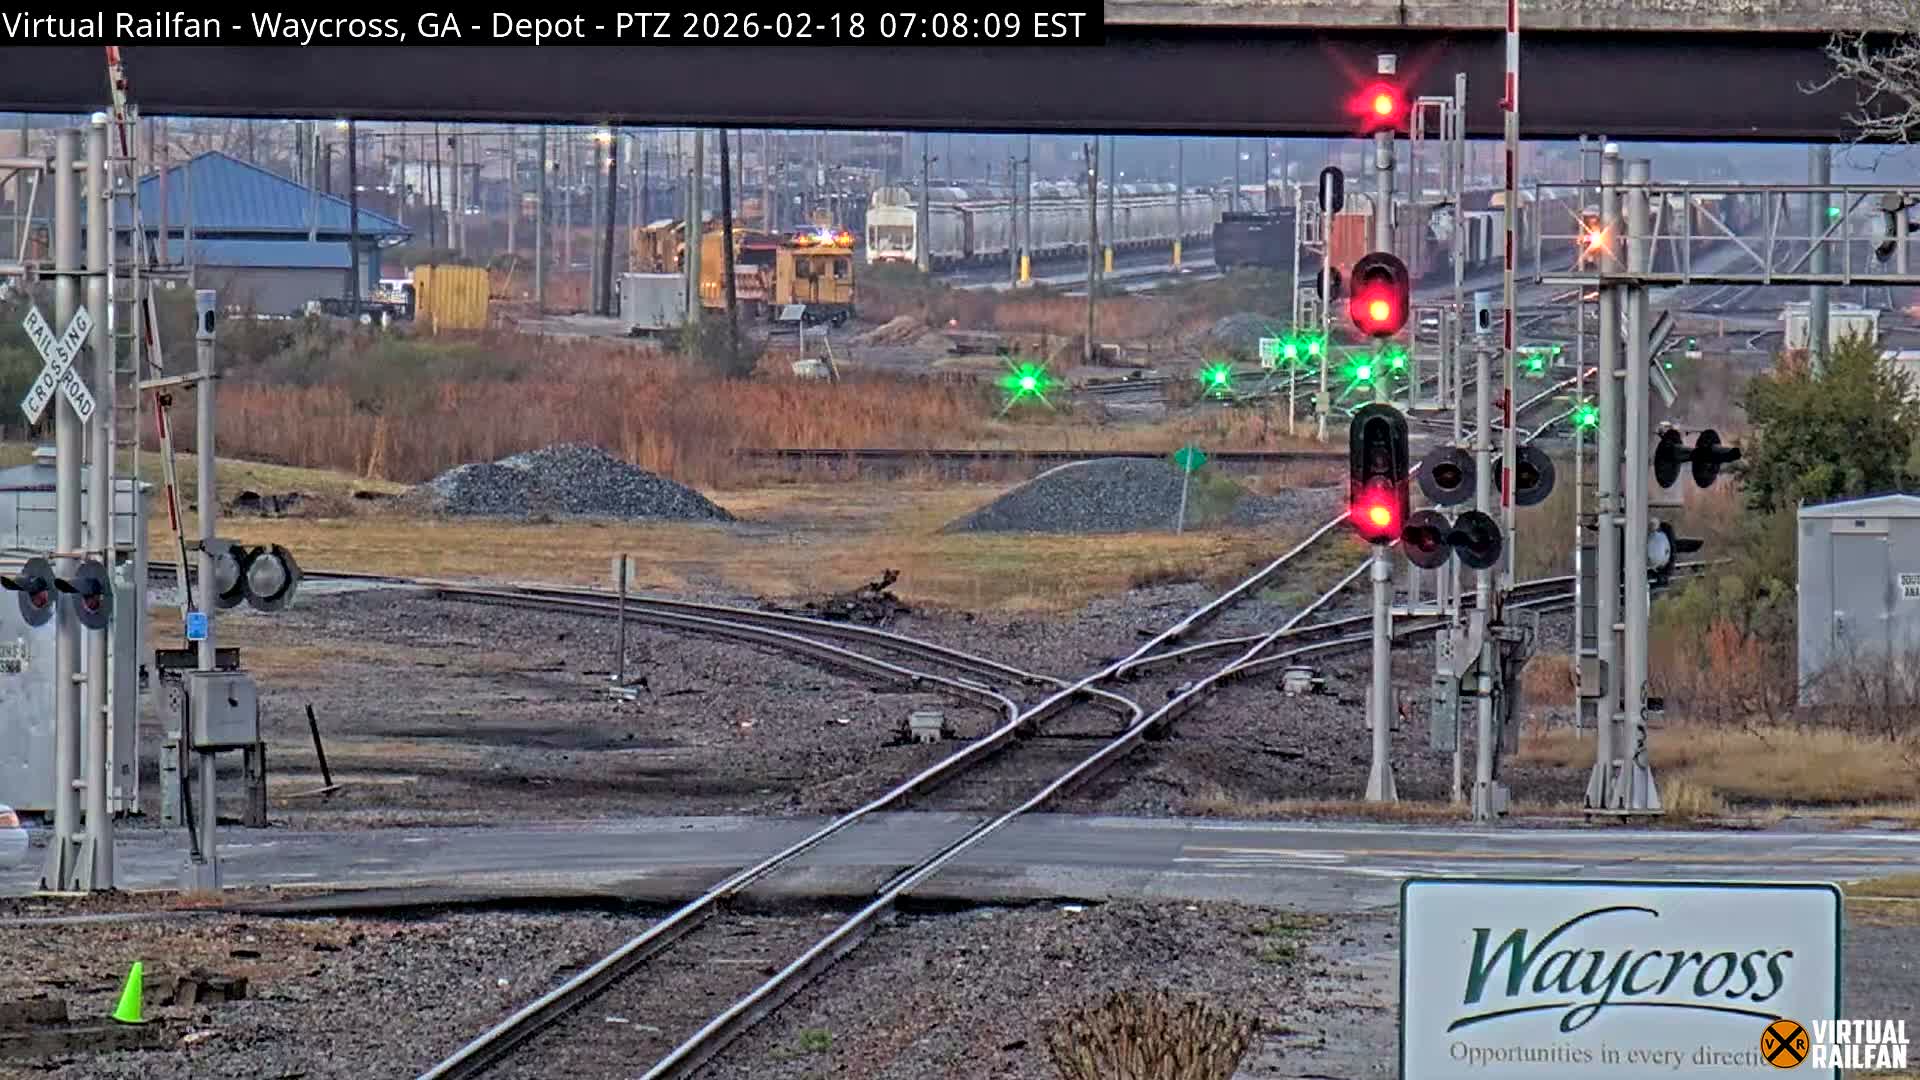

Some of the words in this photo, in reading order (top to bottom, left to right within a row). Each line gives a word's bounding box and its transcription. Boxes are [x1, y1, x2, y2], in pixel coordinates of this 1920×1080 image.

[28, 315, 87, 413] CROSSING
[1463, 906, 1794, 1032] Waycross
[1449, 1041, 1593, 1067] Opportunities
[1601, 1043, 1620, 1064] in
[1627, 1049, 1684, 1070] every
